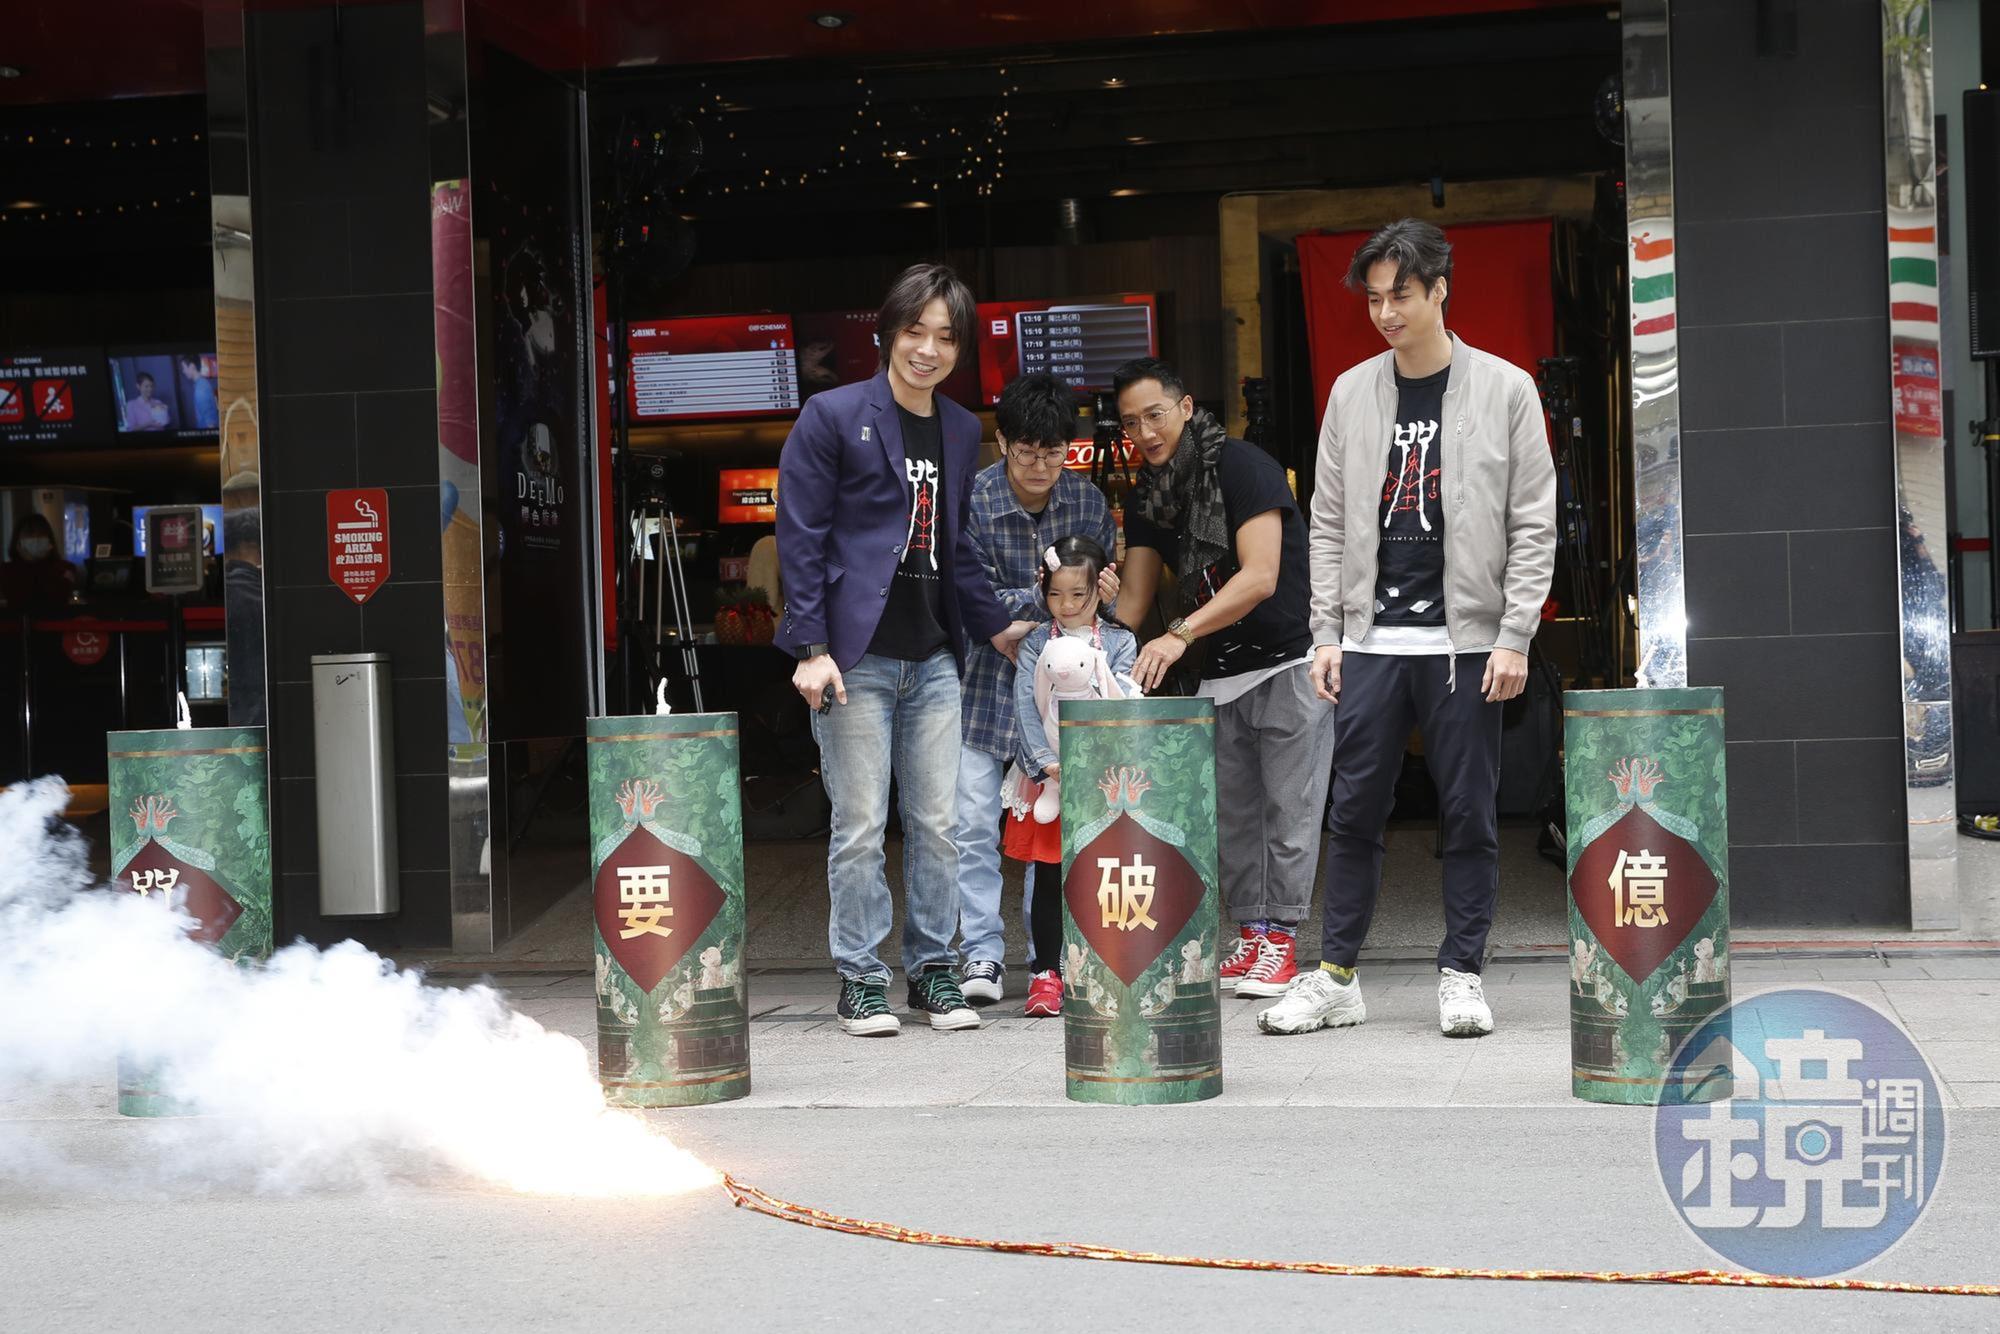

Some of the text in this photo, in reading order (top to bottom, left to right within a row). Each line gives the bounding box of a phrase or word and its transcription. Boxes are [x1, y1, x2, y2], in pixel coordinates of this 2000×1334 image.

[1023, 315, 1042, 323] 13:10
[1024, 328, 1043, 336] 15:10
[1026, 353, 1045, 361] 19:10
[517, 472, 564, 507] DEEMO
[334, 532, 383, 543] SMOKING
[345, 543, 373, 554] AREA
[1097, 854, 1159, 932] 破
[1608, 849, 1669, 928] 億
[616, 865, 674, 940] 要
